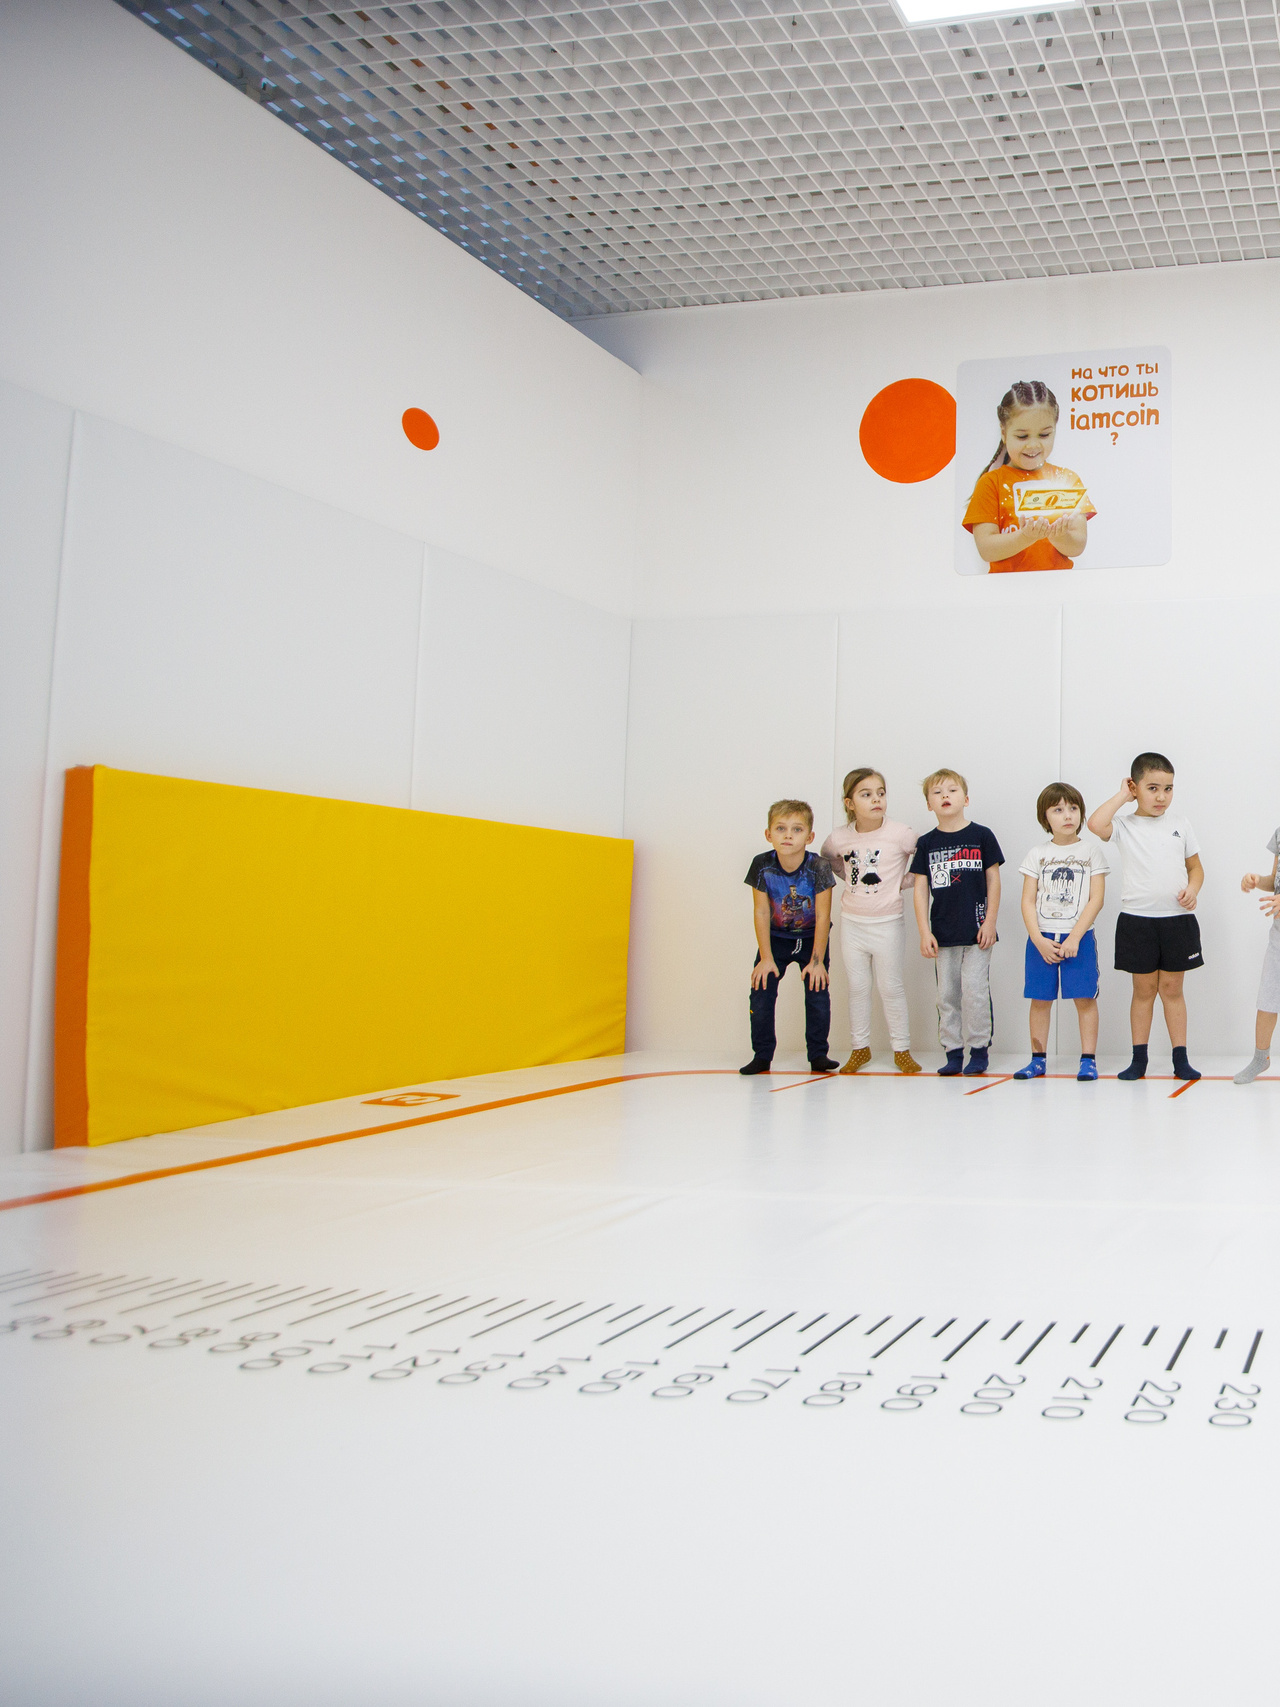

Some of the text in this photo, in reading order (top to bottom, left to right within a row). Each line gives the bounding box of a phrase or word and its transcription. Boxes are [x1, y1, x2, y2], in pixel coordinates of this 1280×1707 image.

[1071, 362, 1159, 380] на что ты
[1070, 402, 1160, 430] iamcoin
[1110, 431, 1119, 446] ?
[930, 861, 982, 872] FREEDOM
[239, 1338, 335, 1371] 100
[306, 1342, 397, 1375] 110
[369, 1346, 460, 1381] 120
[437, 1350, 526, 1385] 130
[506, 1355, 592, 1390] 140
[578, 1359, 660, 1395] 150
[651, 1362, 730, 1399] 160
[725, 1366, 801, 1404] 170
[802, 1369, 874, 1407] 180
[880, 1373, 948, 1412] 190
[959, 1373, 1027, 1416] 200
[1041, 1376, 1104, 1420] 210
[1123, 1379, 1182, 1424] 220
[1208, 1383, 1262, 1428] 230
